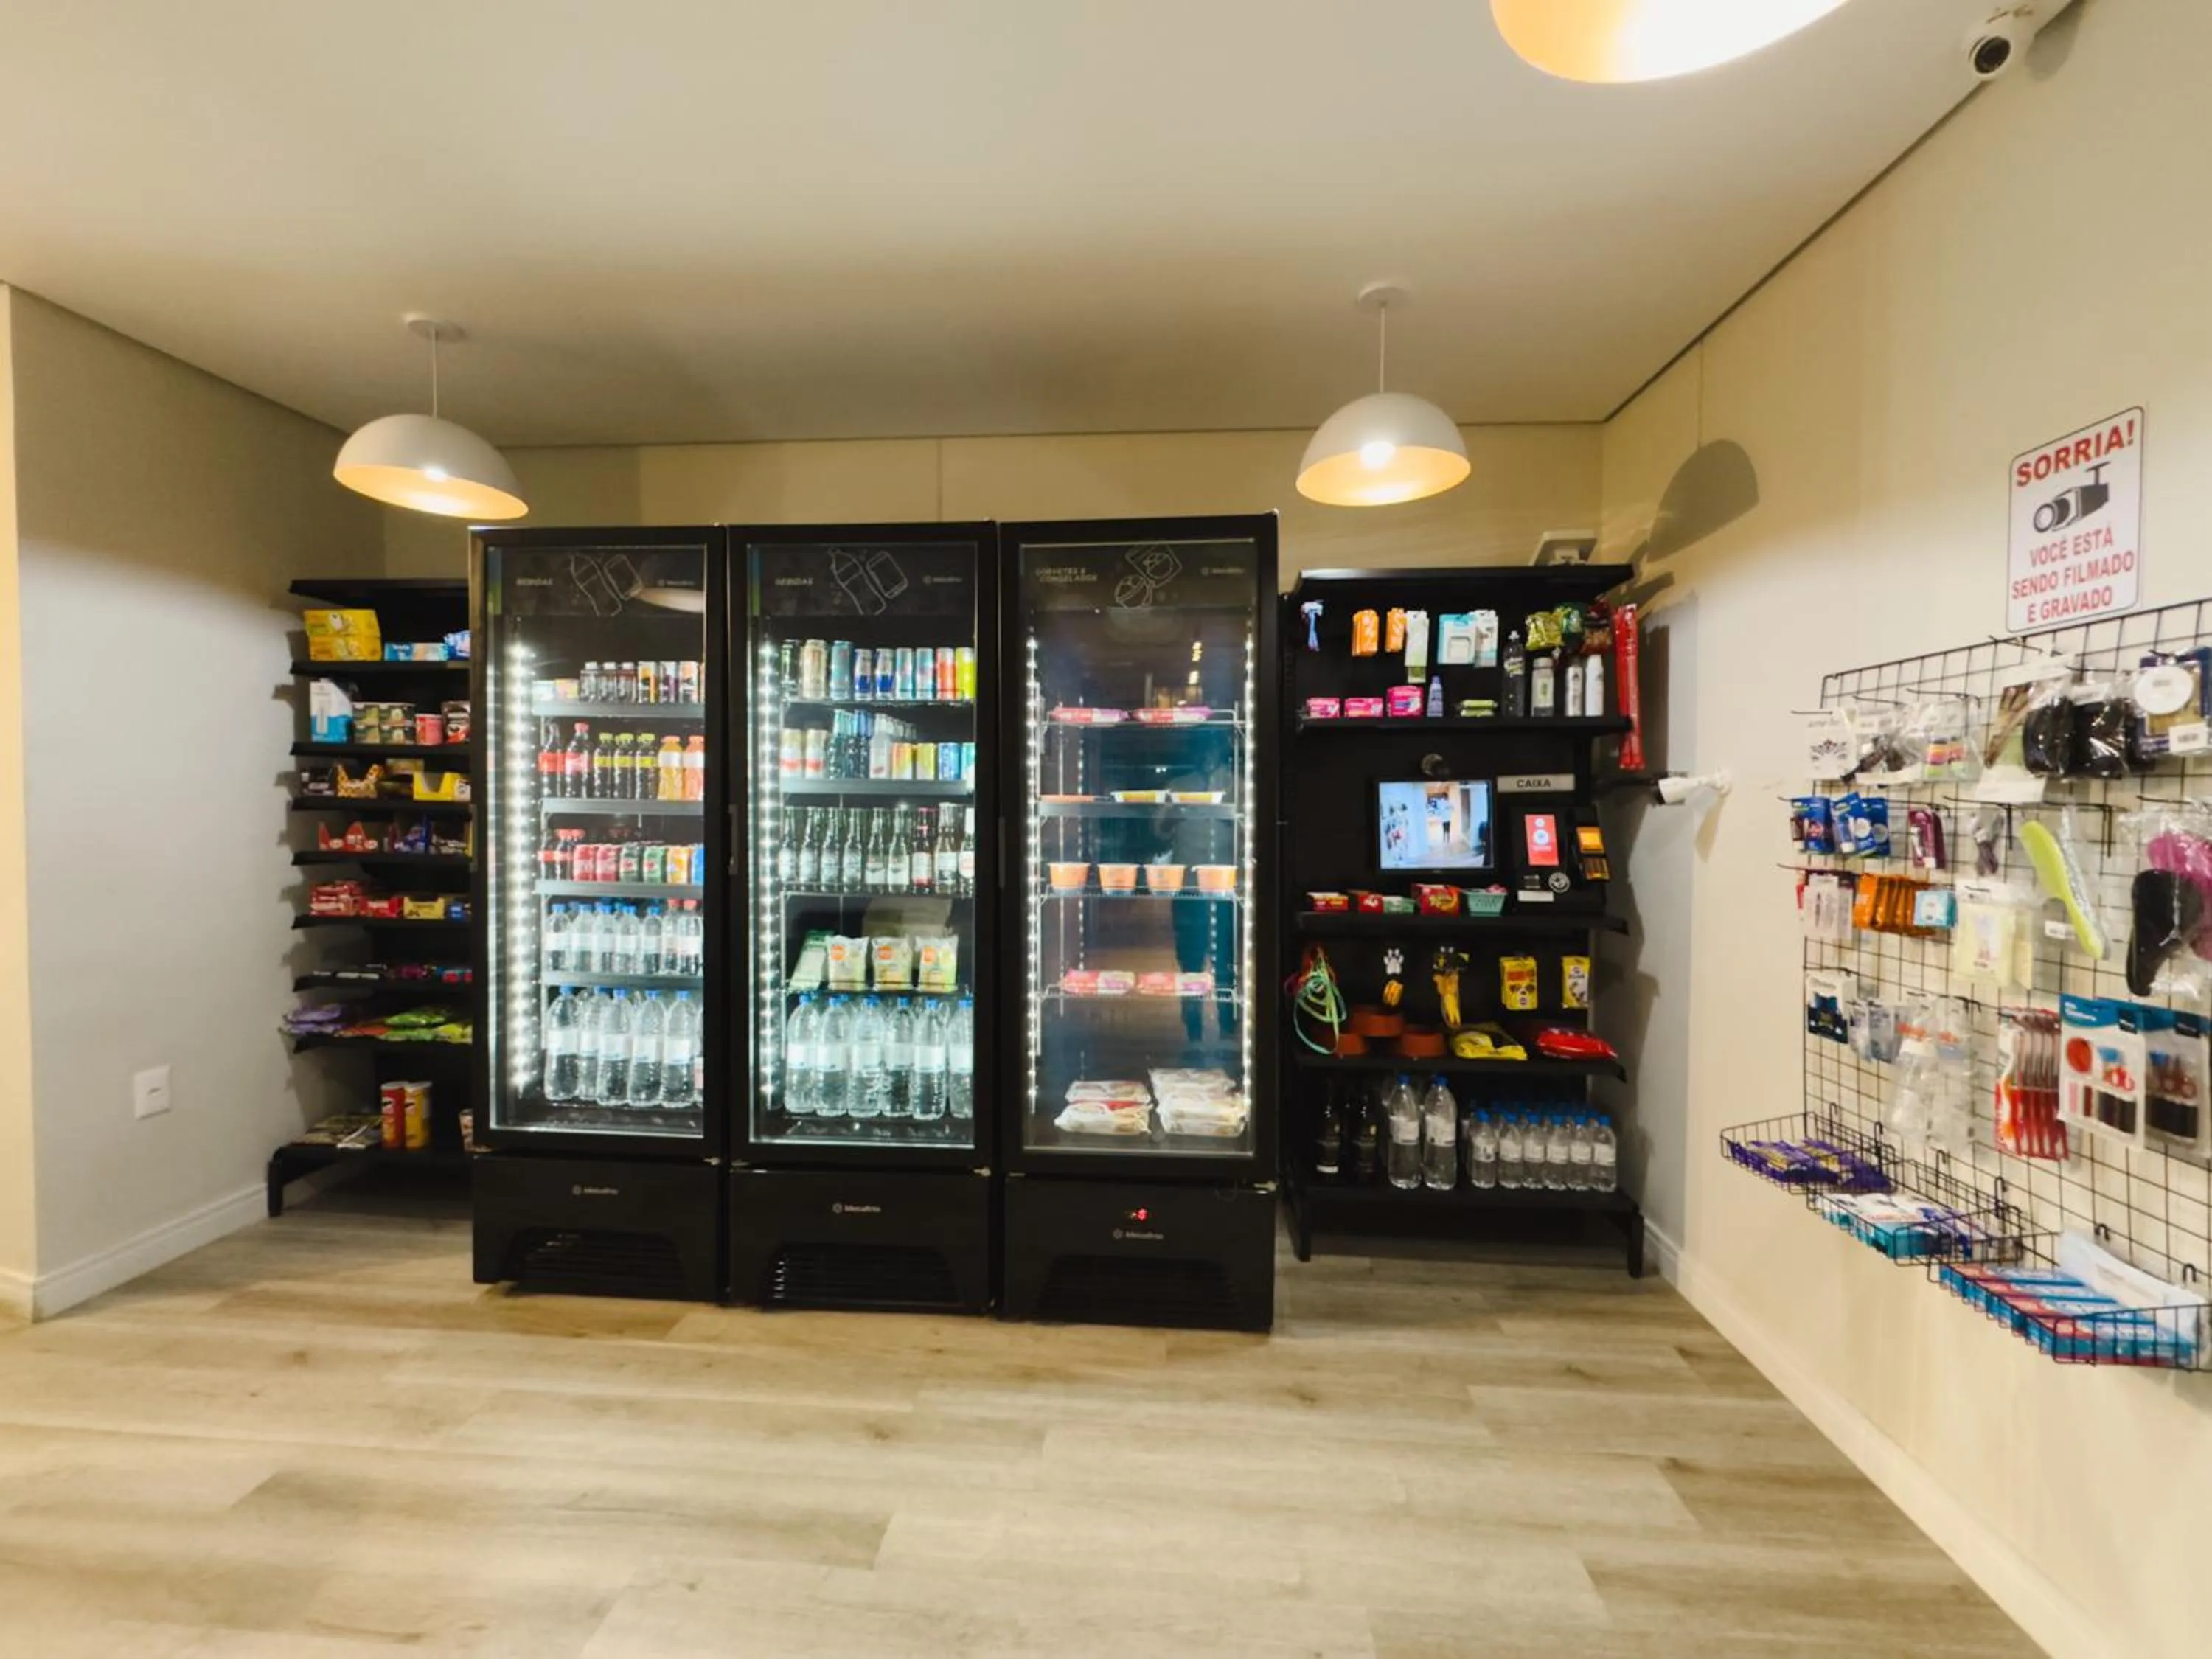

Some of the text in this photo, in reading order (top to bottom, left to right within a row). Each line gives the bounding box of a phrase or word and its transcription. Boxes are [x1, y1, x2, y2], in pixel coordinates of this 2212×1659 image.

[2016, 418, 2135, 487] SORRIA!
[2029, 521, 2114, 568] VOCÊ ESTÁ
[2011, 550, 2135, 599] SENDO FILMADO
[2027, 586, 2113, 623] E GRAVADO
[1516, 779, 1551, 788] CAIXA
